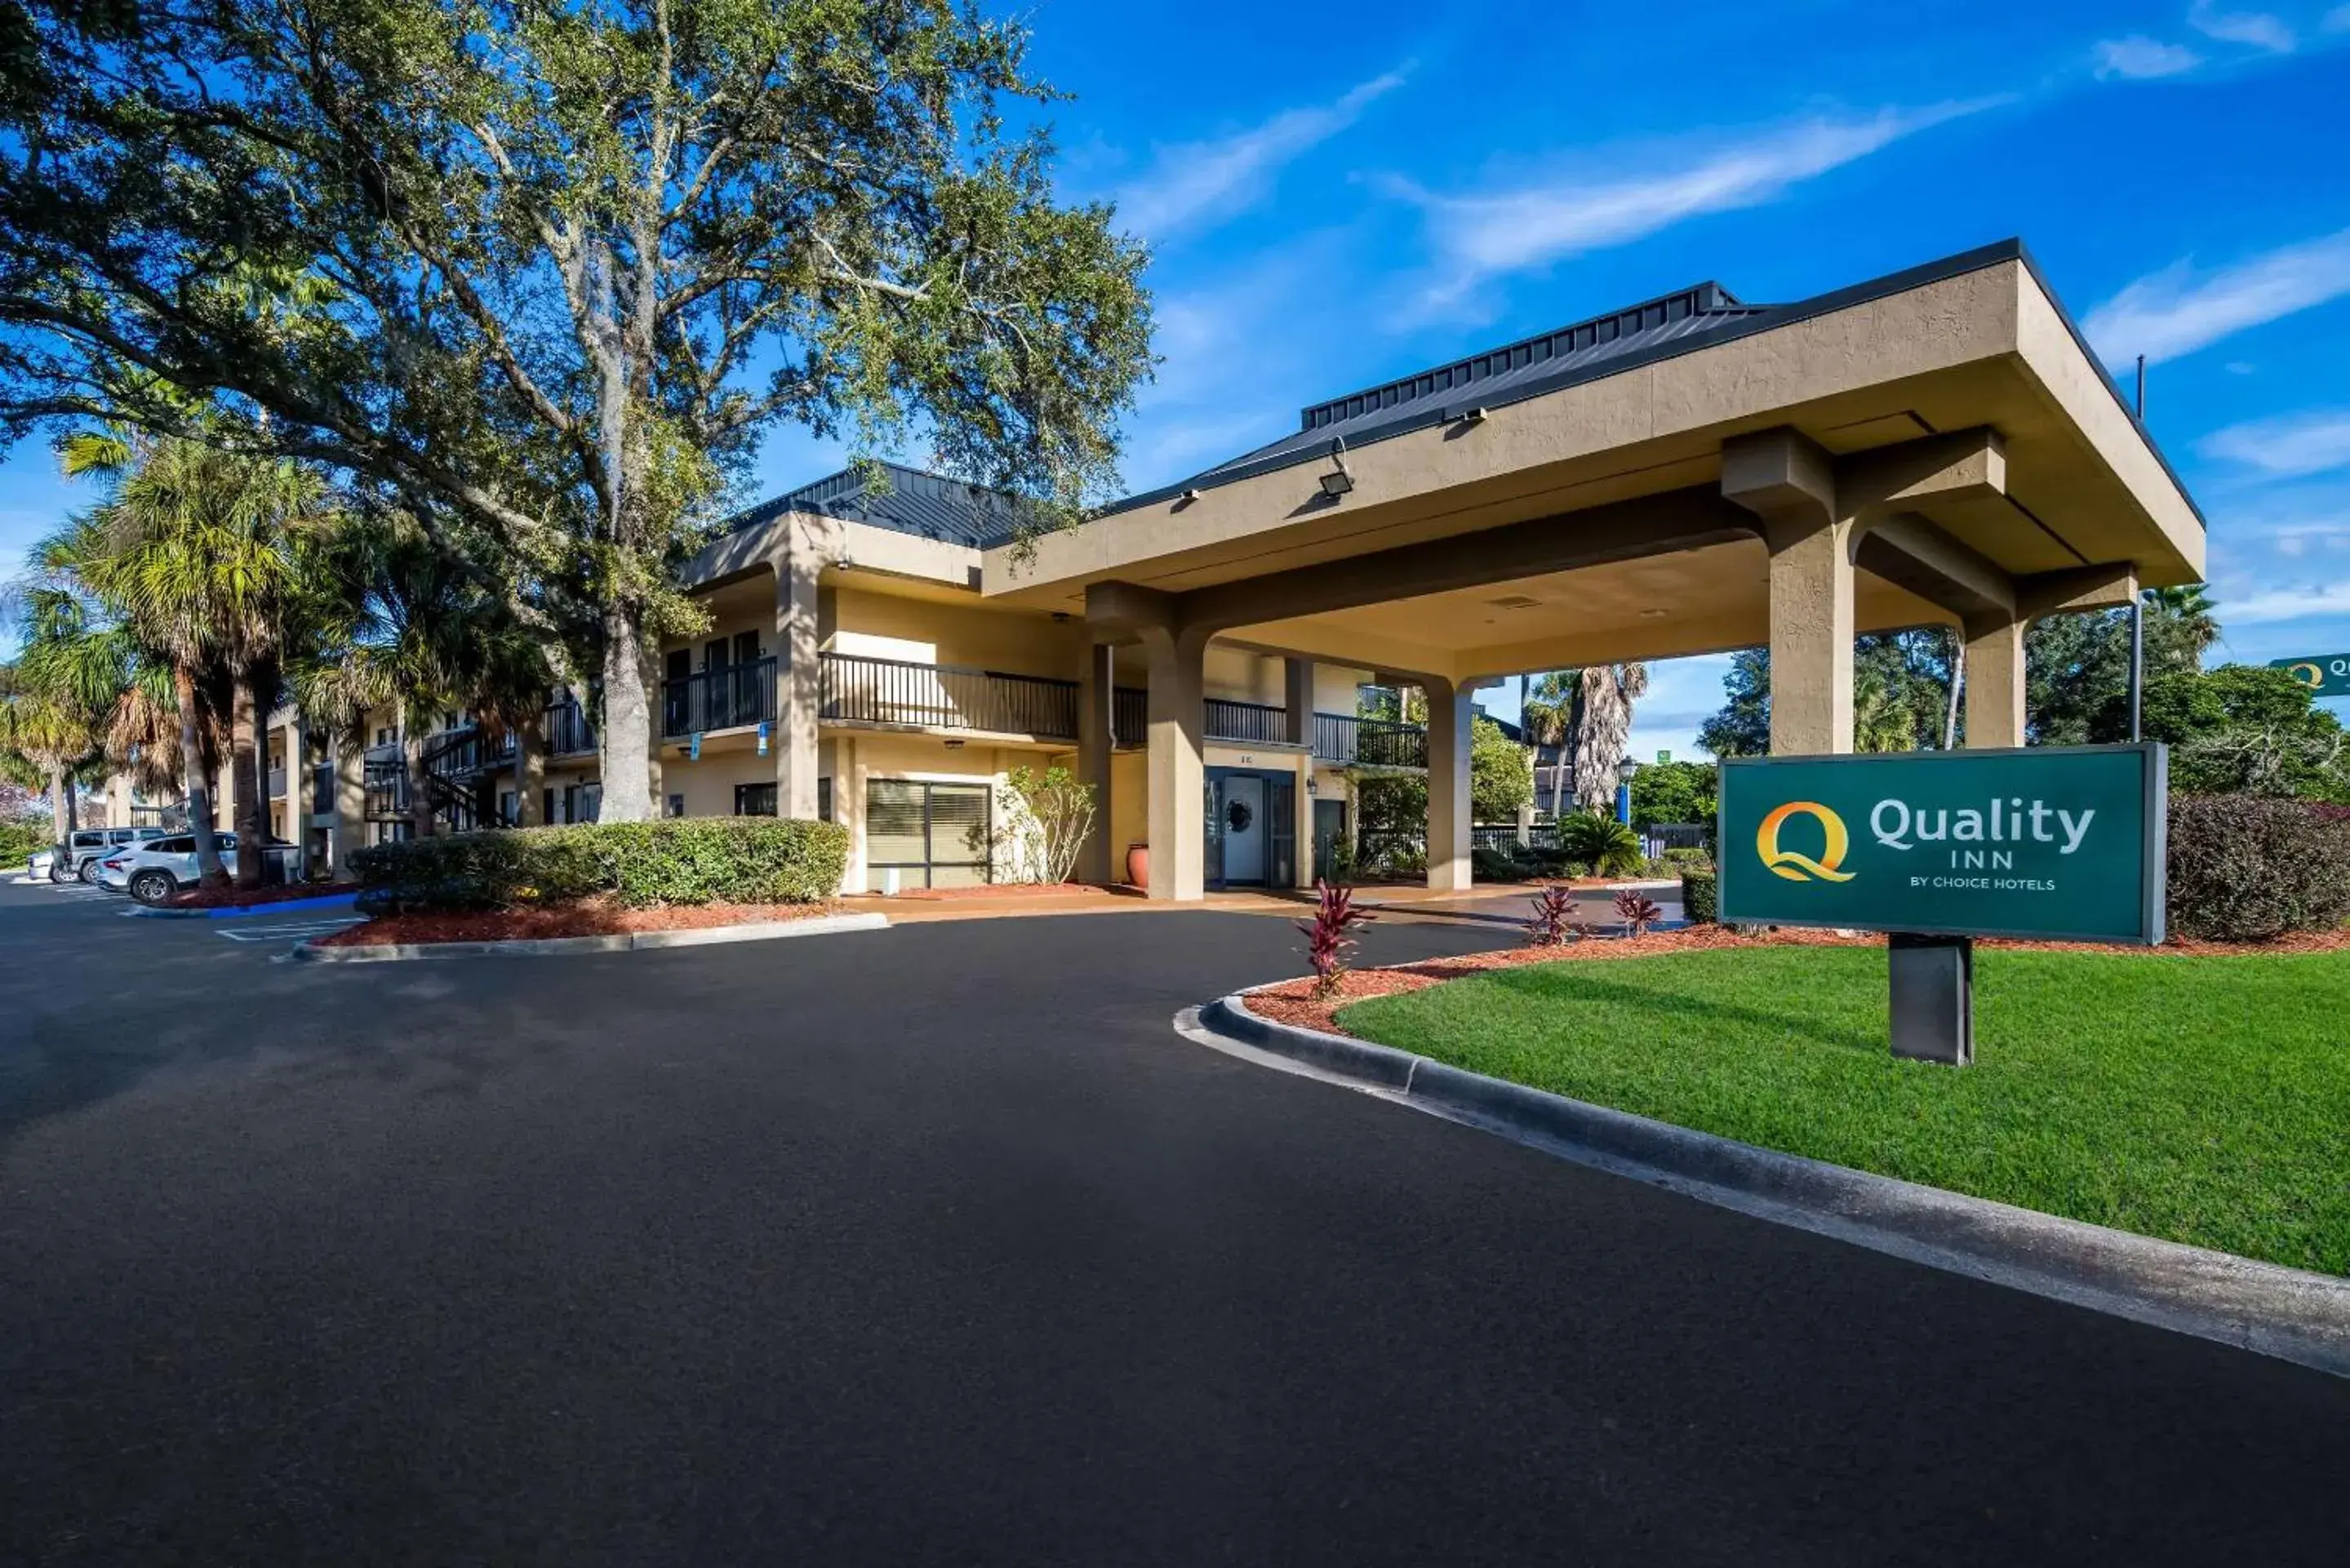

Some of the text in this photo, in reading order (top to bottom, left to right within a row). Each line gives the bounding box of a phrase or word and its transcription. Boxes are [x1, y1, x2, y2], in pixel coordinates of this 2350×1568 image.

[1756, 802, 1857, 882] Q
[1870, 797, 2096, 854] Quality
[1951, 850, 2013, 869] INN
[1910, 877, 2055, 891] BY CHOICE HOTELS
